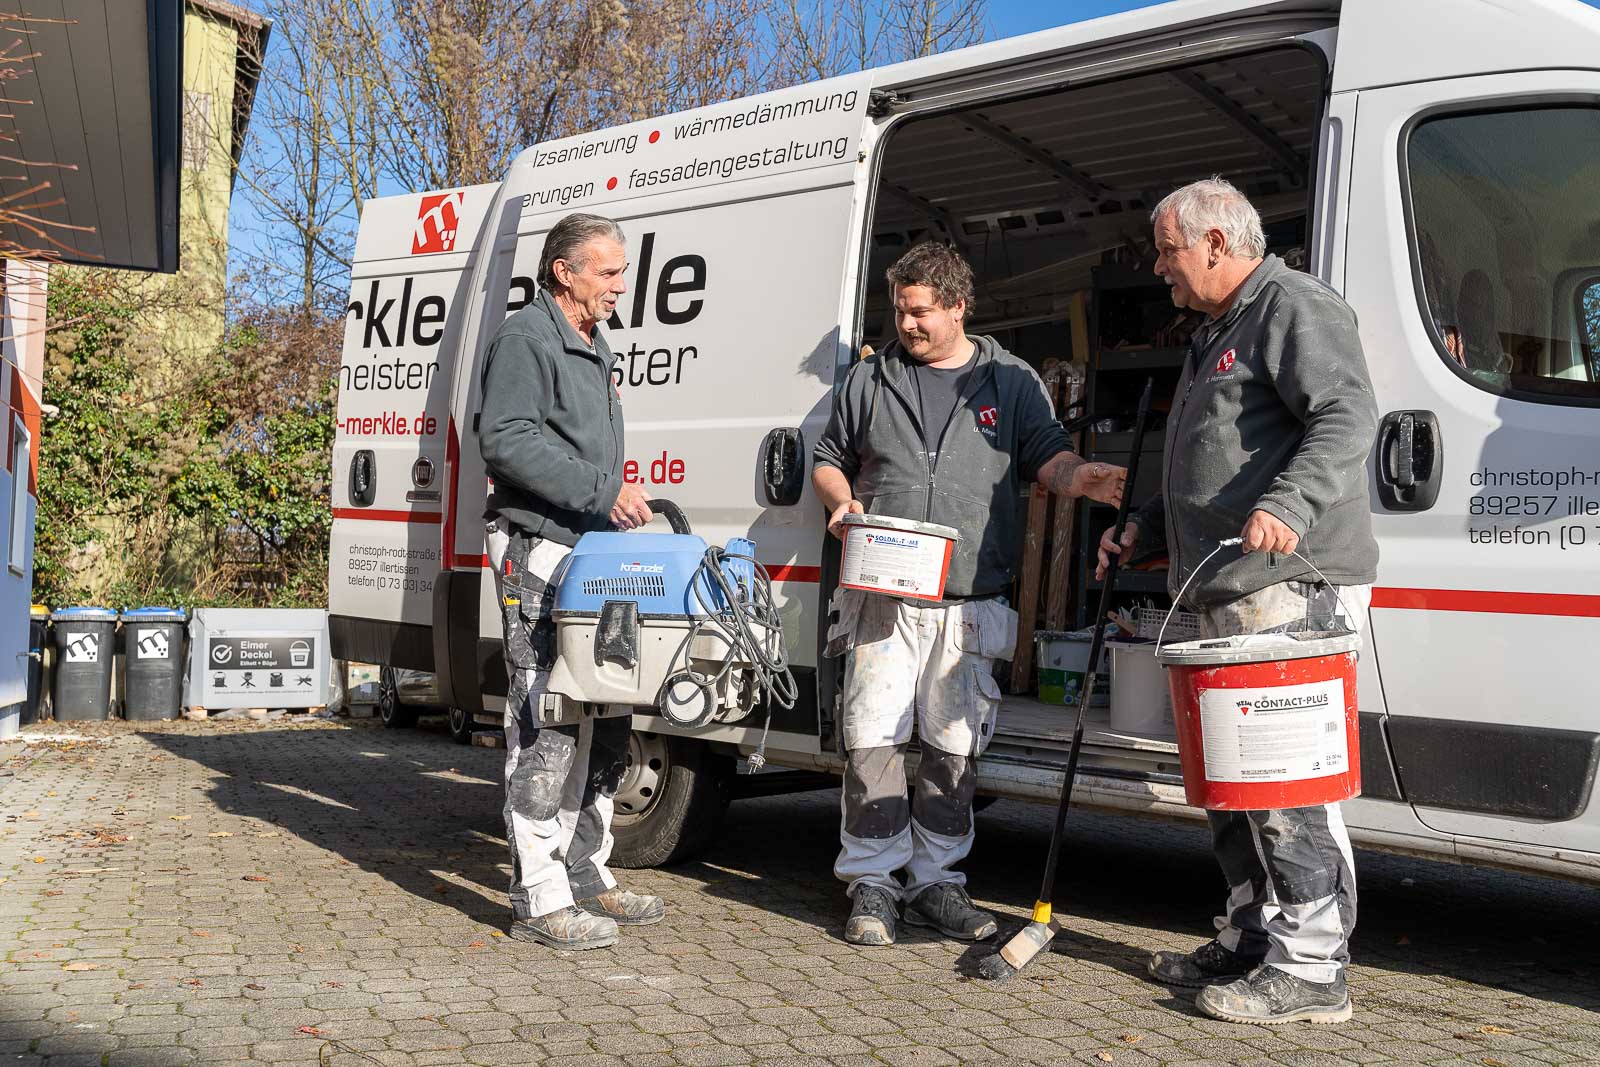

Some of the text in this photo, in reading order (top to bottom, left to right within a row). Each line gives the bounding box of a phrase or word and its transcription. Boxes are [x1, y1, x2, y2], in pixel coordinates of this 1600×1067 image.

[674, 90, 858, 140] wärmedämmung
[522, 136, 848, 208] erungen fassadengestaltung
[336, 411, 437, 435] -merkle.de
[1469, 496, 1558, 516] 89257
[1468, 525, 1550, 545] telefon
[348, 558, 378, 572] 89257
[348, 574, 375, 588] telefon
[388, 577, 401, 590] 73
[420, 580, 433, 593] 34
[240, 640, 269, 650] Eimer
[240, 650, 273, 659] Deckel
[1254, 694, 1328, 709] CONTACT-PLUS
